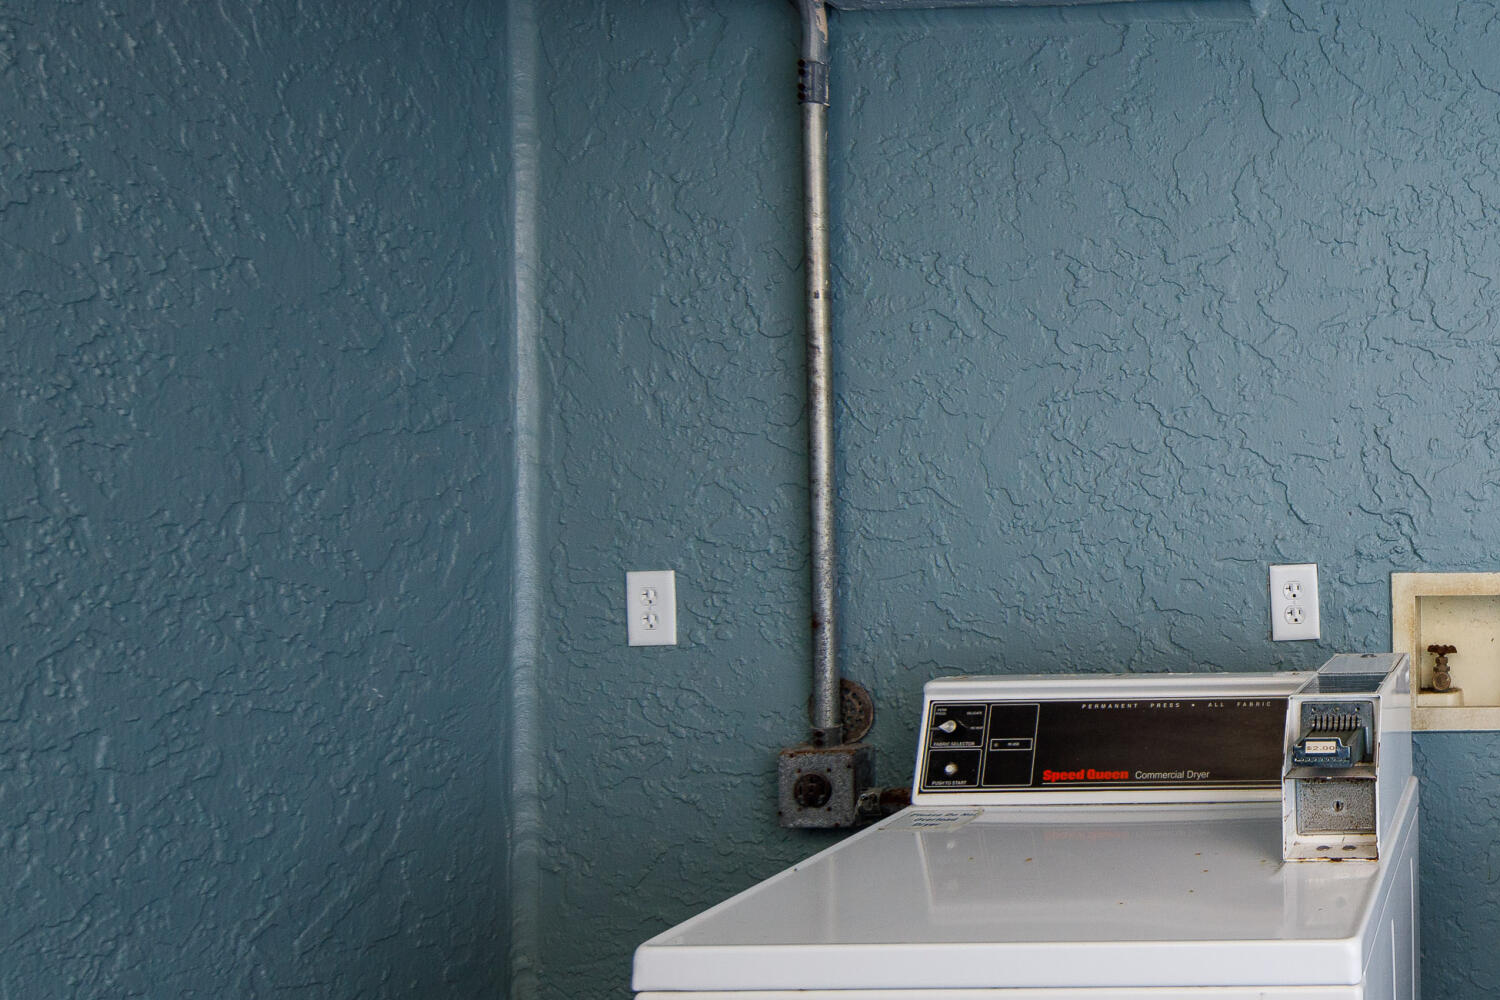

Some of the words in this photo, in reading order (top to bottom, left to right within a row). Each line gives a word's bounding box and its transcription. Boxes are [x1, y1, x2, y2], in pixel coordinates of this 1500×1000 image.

[1042, 769, 1085, 782] Speed
[1087, 768, 1129, 780] Queen
[1135, 770, 1184, 779] Commercial
[1186, 770, 1210, 780] Dryer
